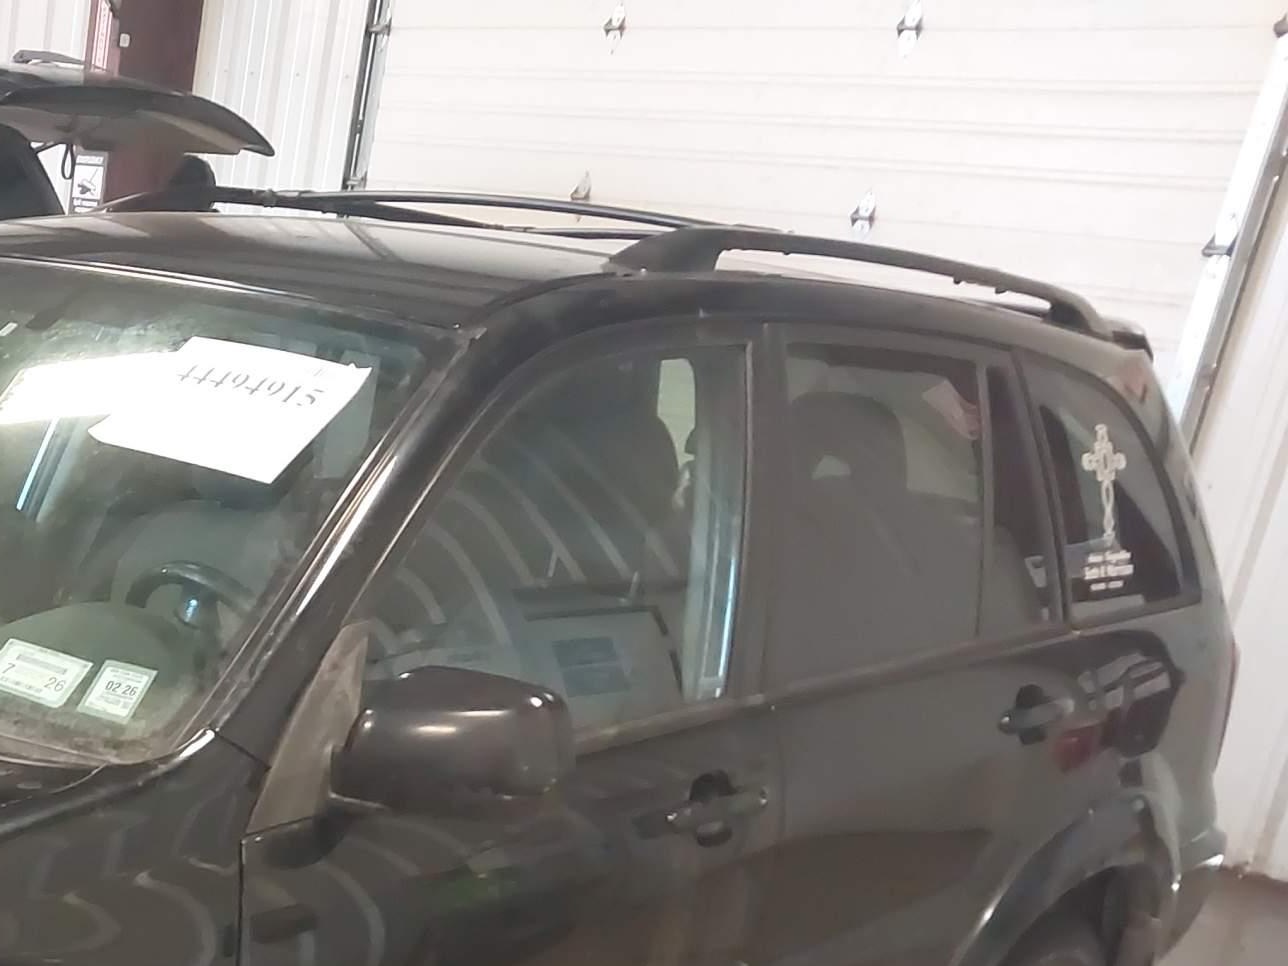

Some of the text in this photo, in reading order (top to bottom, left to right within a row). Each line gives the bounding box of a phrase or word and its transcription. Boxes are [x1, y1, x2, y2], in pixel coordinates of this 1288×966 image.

[177, 364, 325, 407] 44494915
[2, 662, 16, 674] 7
[43, 676, 66, 693] 26
[105, 680, 139, 697] 02 26
